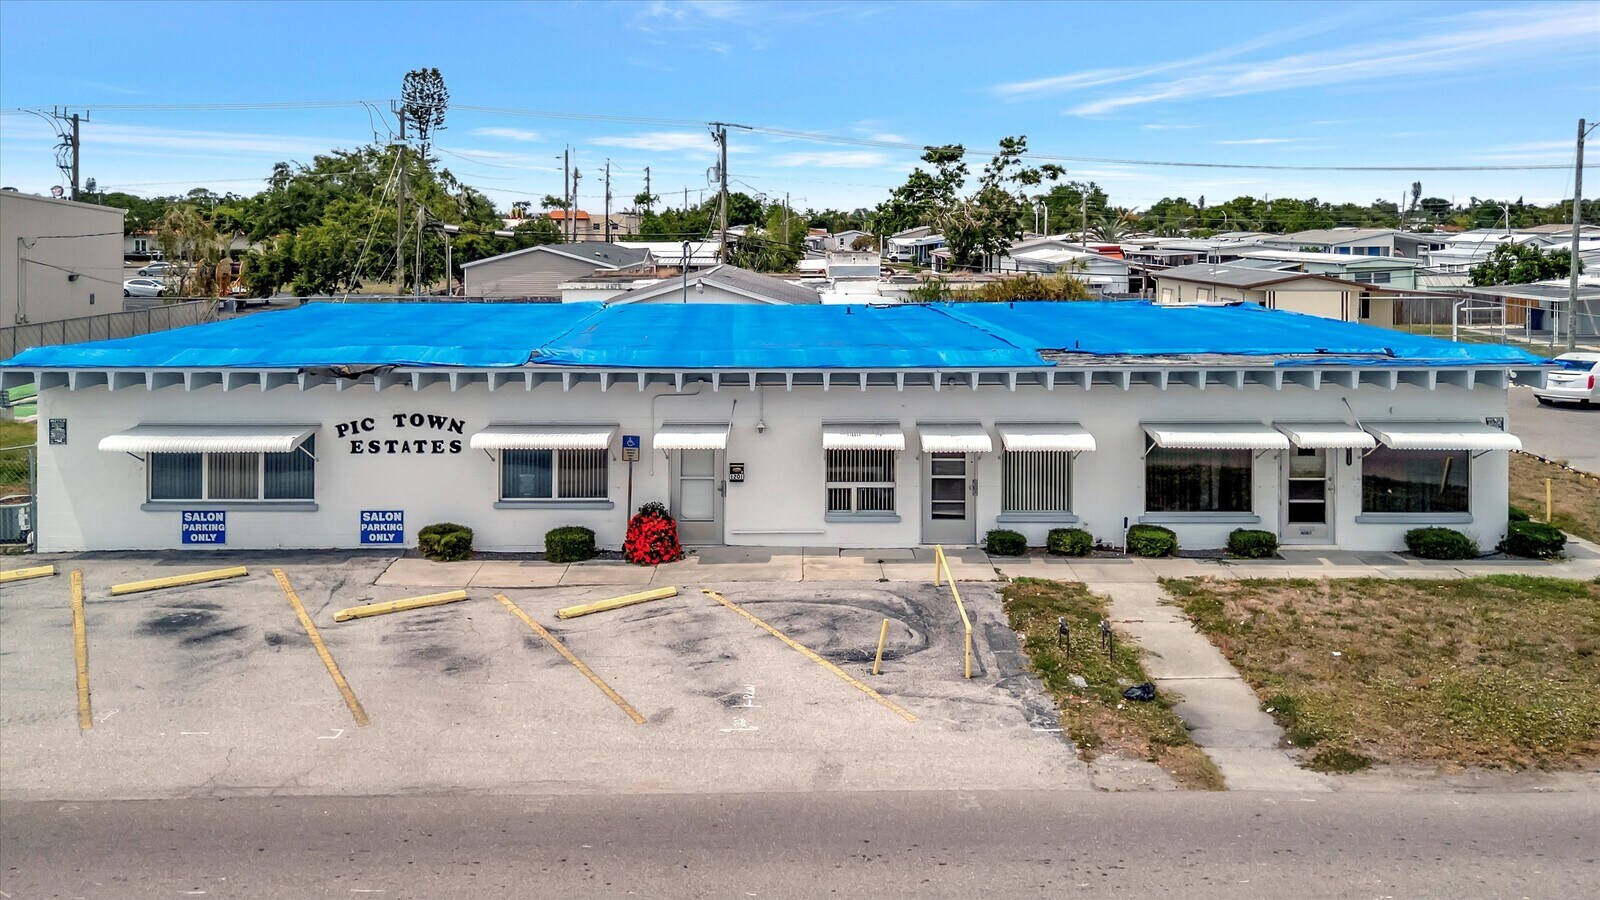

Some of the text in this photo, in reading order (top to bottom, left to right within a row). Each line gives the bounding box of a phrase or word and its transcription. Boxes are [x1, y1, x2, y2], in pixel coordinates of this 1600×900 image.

[335, 413, 466, 438] PIC TOWN
[350, 440, 462, 454] ESTATES
[184, 512, 224, 522] SALON
[363, 512, 402, 522] SALON
[183, 523, 225, 531] PARKING
[361, 523, 403, 531] PARKING
[190, 533, 217, 542] ONLY
[369, 533, 395, 542] ONLY
